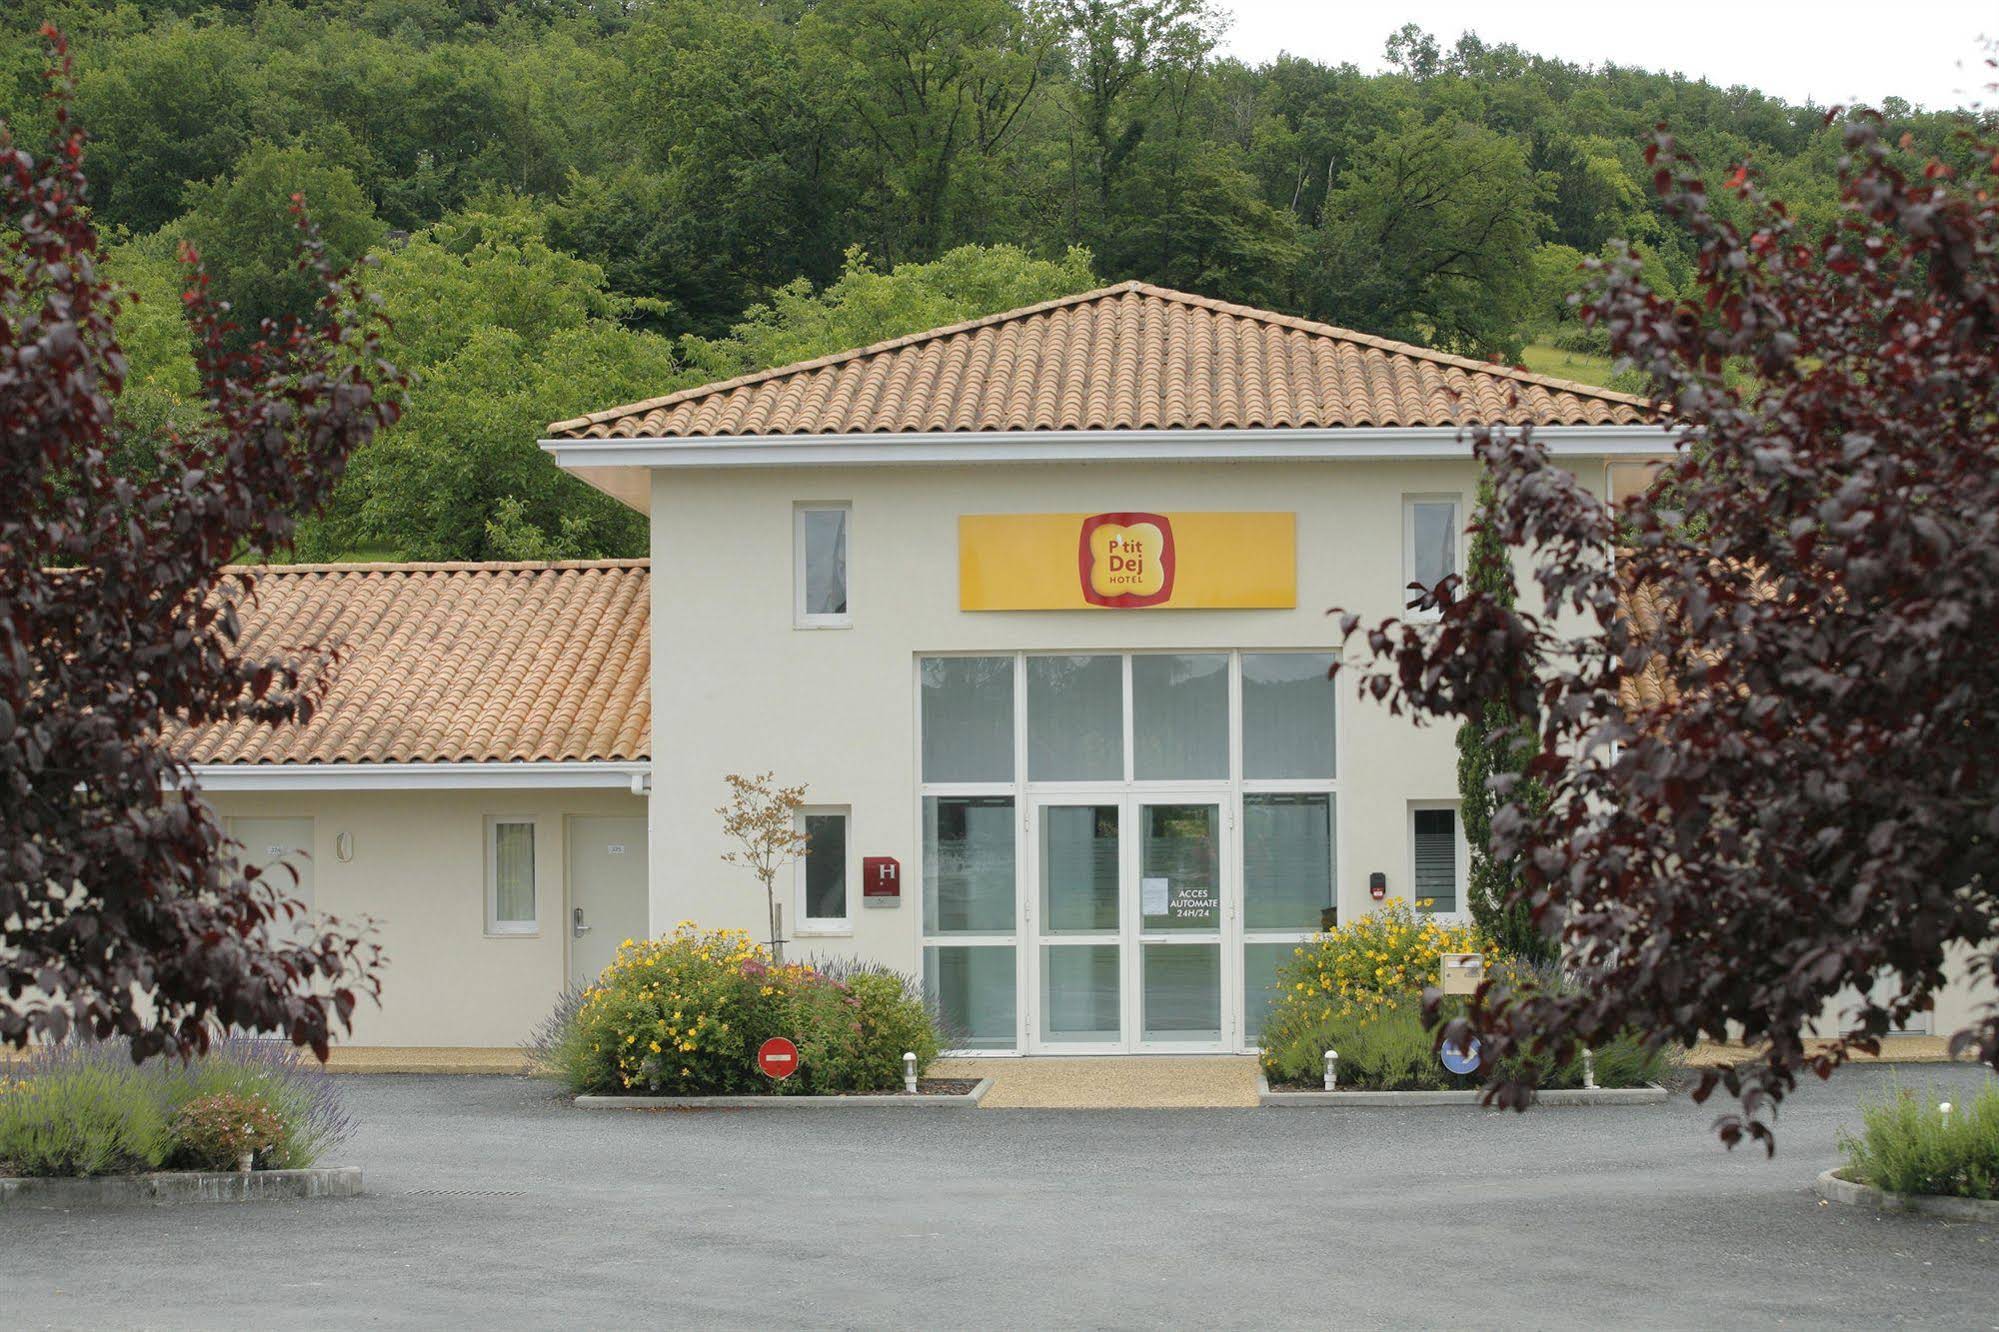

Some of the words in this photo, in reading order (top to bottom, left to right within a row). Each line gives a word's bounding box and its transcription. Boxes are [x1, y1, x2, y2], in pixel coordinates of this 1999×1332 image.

[1109, 554, 1143, 575] Dej
[1109, 576, 1143, 584] HOTEL
[880, 864, 895, 879] H
[1178, 889, 1208, 898] ACCES
[1169, 899, 1219, 908] AUTOMATE
[1176, 909, 1210, 918] 24H/24
